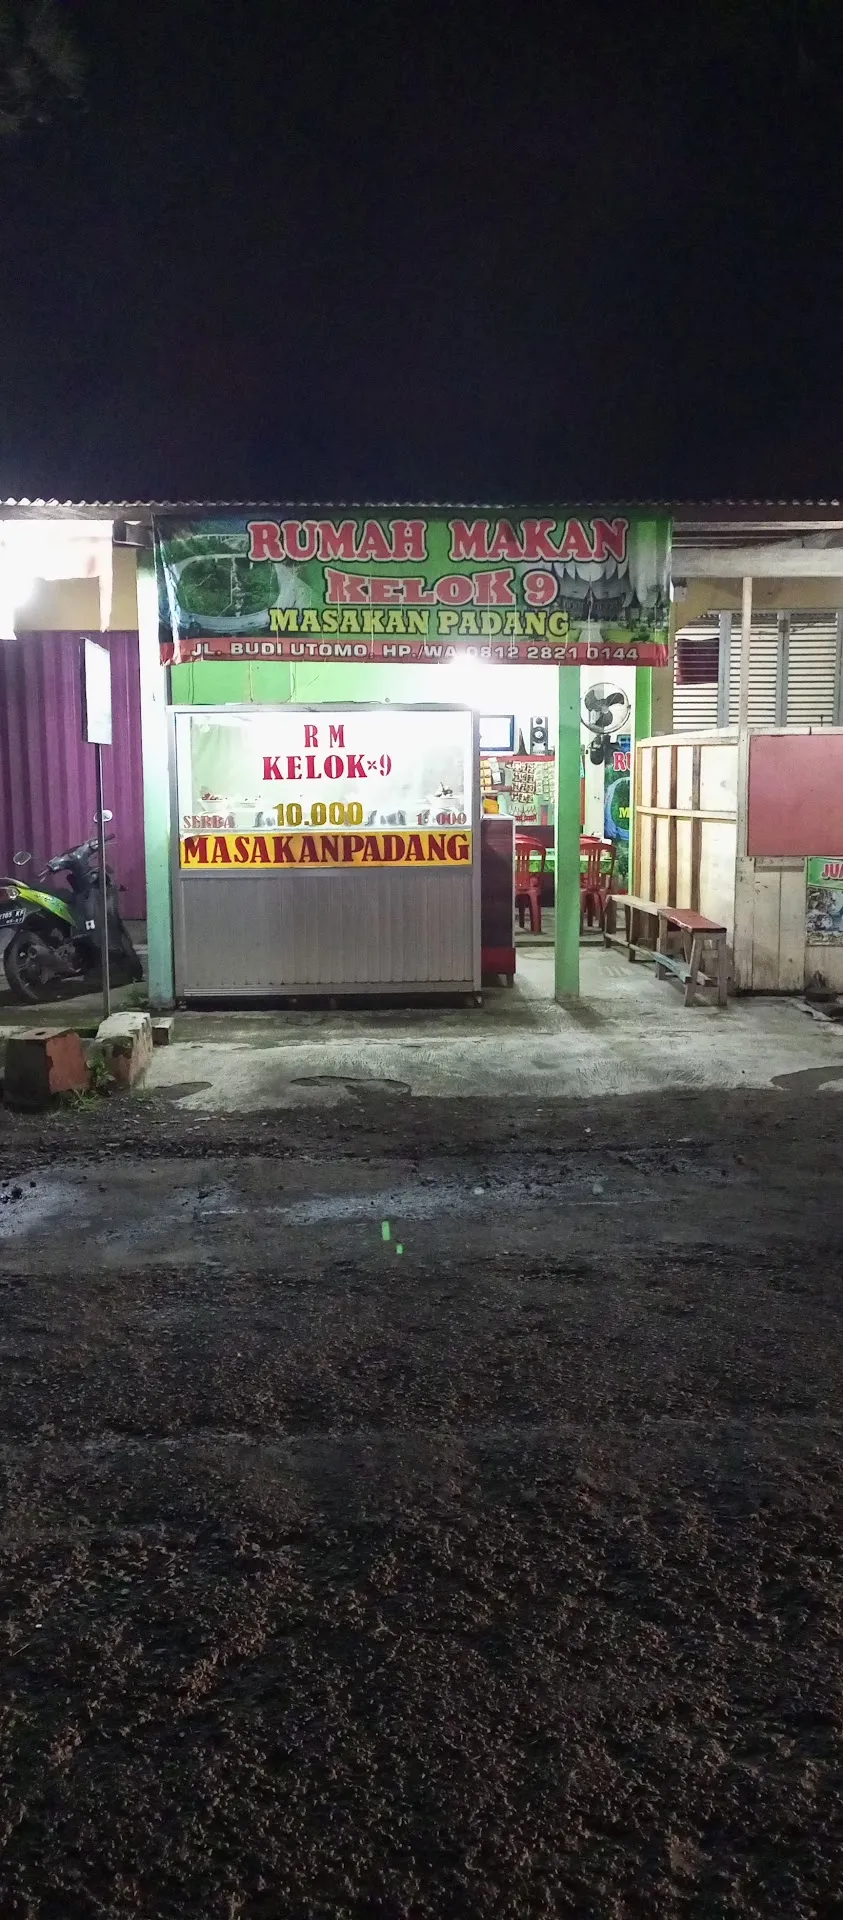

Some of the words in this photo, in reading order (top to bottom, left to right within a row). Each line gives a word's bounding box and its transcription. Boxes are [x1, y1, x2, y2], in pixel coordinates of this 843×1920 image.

[246, 520, 427, 561] RUMAH
[449, 519, 628, 562] MAKAN
[325, 568, 515, 606] KELOK
[524, 568, 559, 606] 9
[269, 608, 433, 635] MASAKAN
[437, 609, 570, 637] PADANG
[191, 642, 222, 657] JL.
[230, 642, 283, 655] BUDI
[466, 644, 520, 659] 0812
[527, 645, 578, 661] 2821
[586, 646, 639, 661] 0144
[273, 801, 364, 827] 10.000
